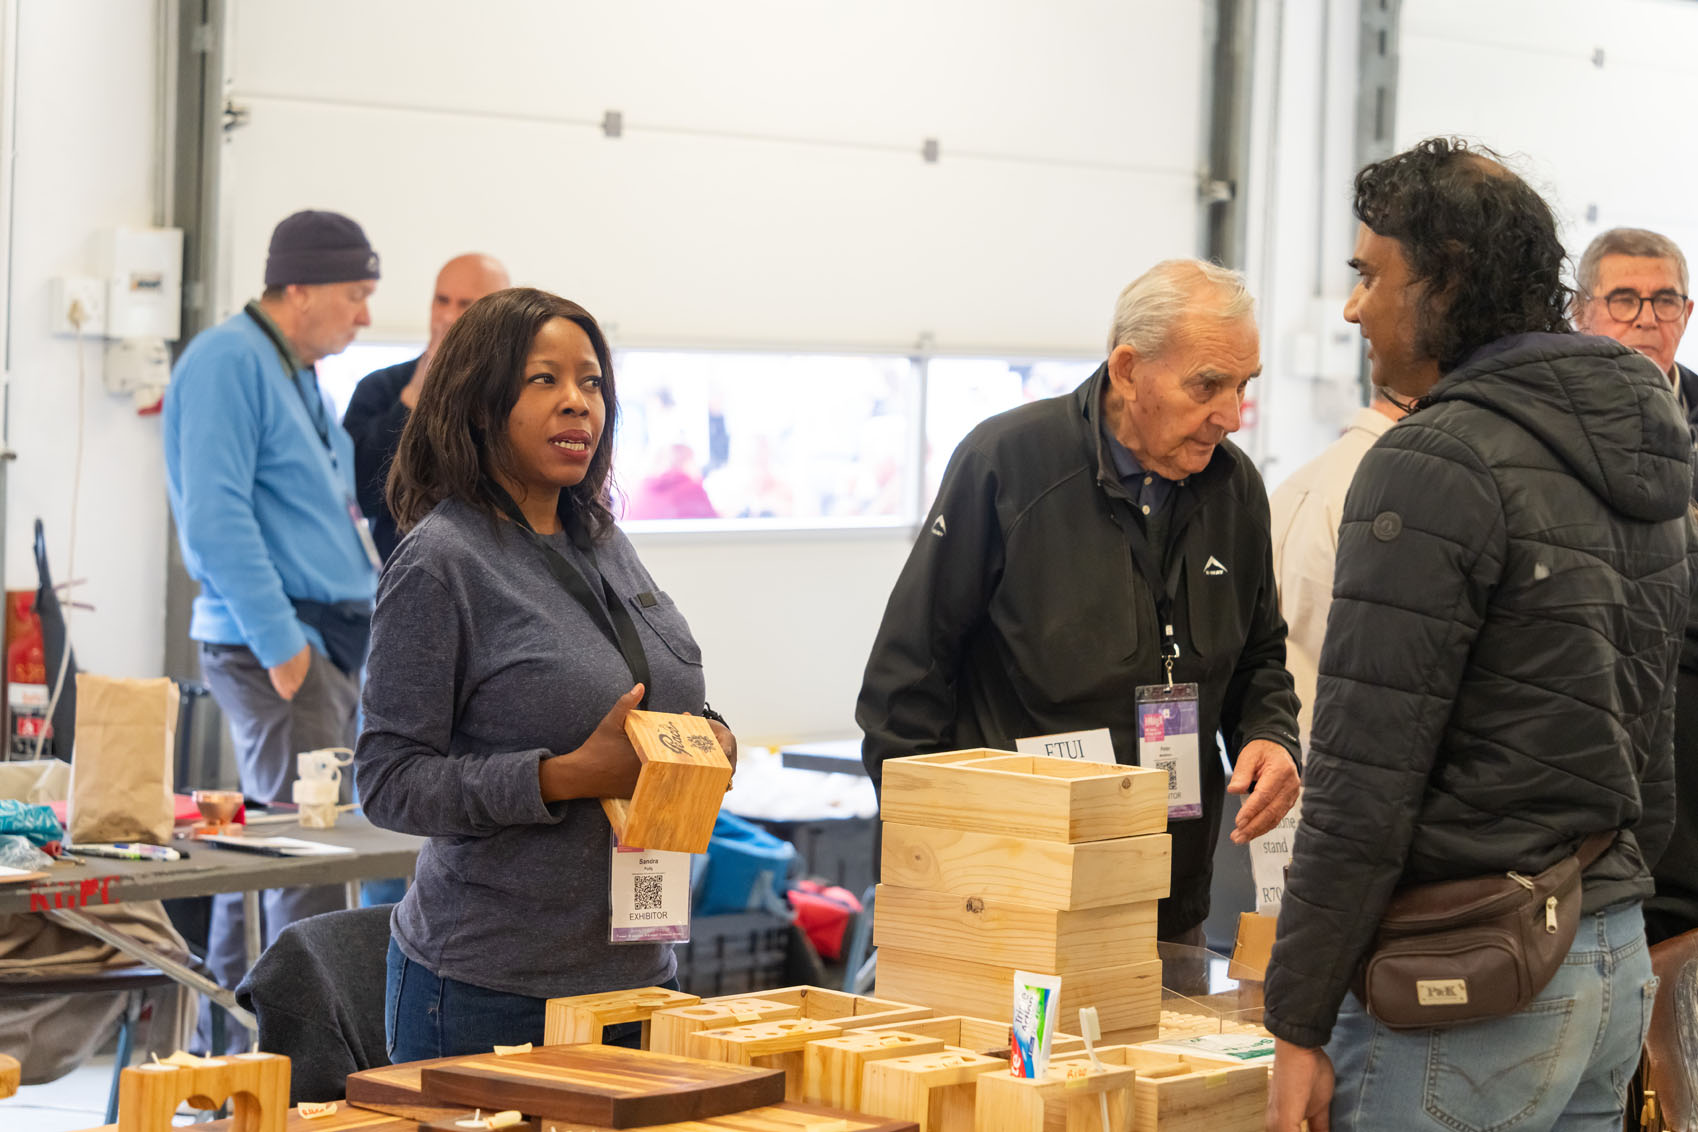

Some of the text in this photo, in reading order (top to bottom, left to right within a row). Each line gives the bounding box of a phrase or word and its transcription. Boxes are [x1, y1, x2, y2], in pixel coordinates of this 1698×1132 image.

[1278, 817, 1296, 829] one
[1263, 839, 1288, 854] stand
[629, 912, 668, 920] EXHIBITOR
